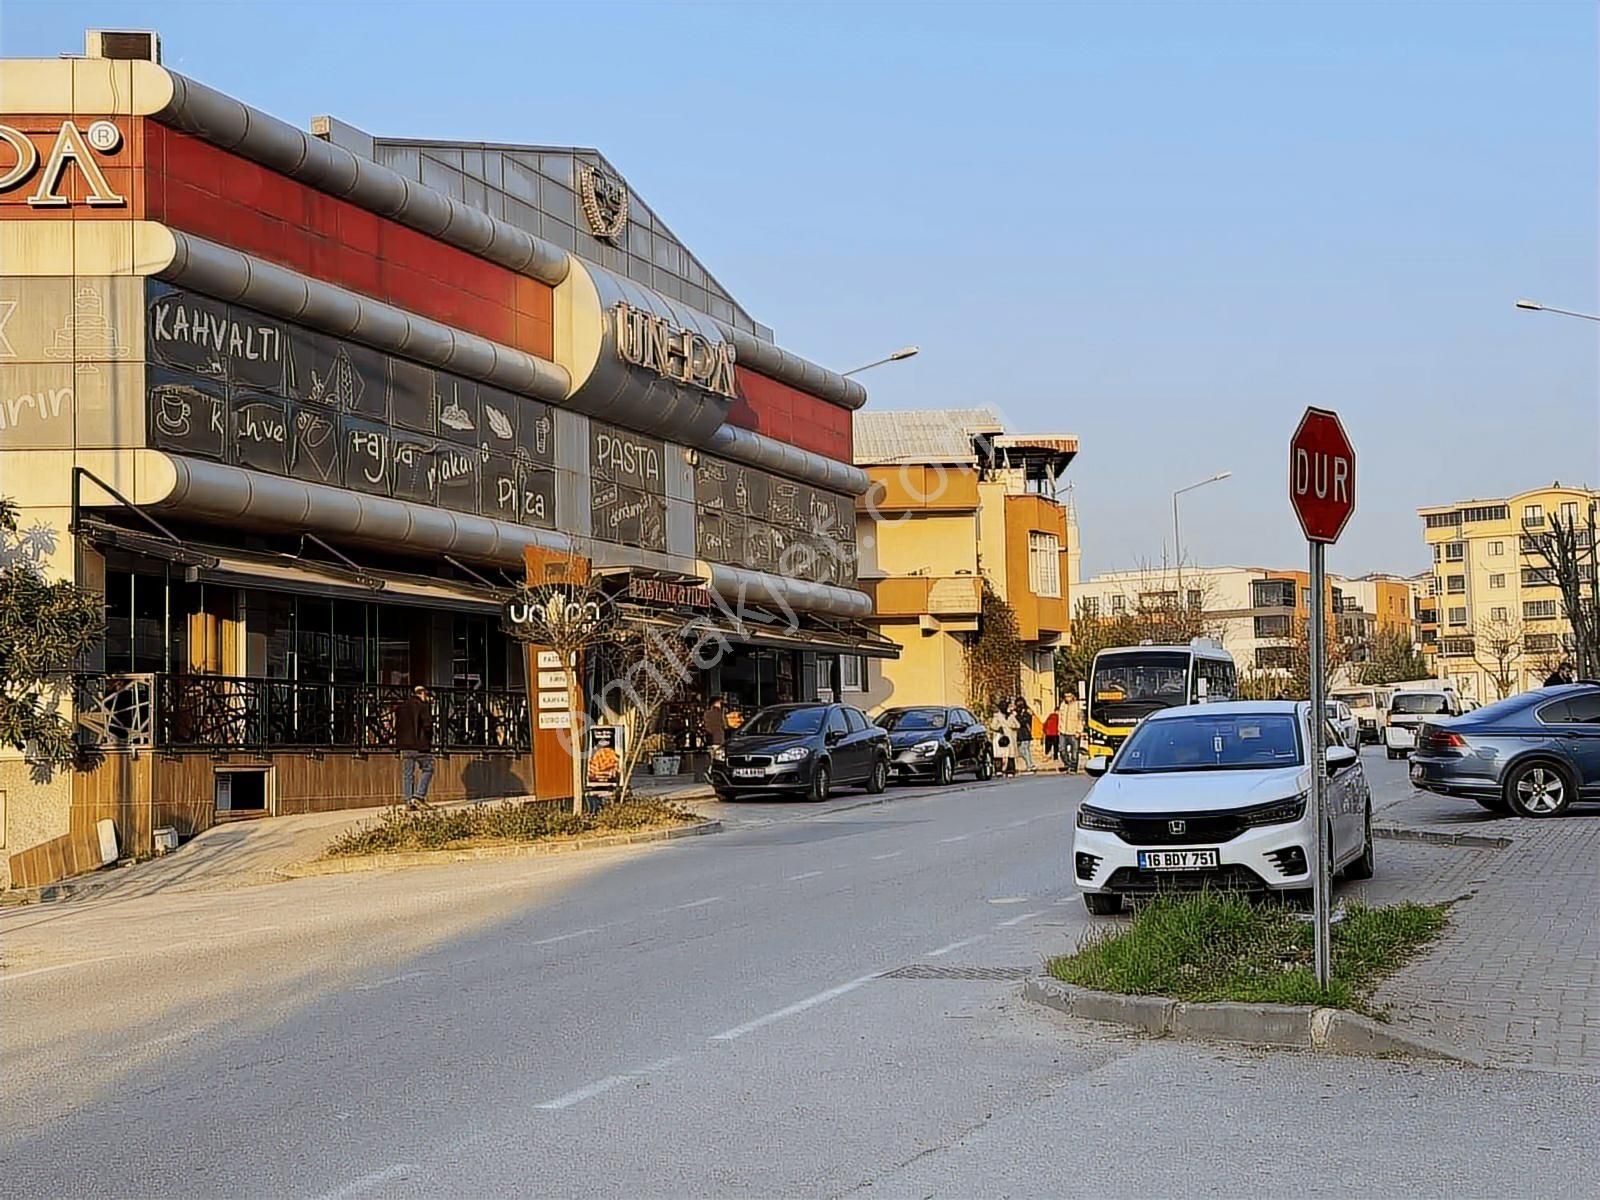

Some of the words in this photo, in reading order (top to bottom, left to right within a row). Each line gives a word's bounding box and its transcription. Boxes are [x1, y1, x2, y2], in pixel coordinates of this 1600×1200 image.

[155, 304, 280, 361] KAHVALTI
[211, 402, 285, 442] Khve
[597, 433, 659, 481] PASTA
[1297, 447, 1348, 504] DUR
[498, 477, 545, 520] Piza
[1147, 854, 1161, 867] 16
[1164, 853, 1188, 867] BDY
[1191, 851, 1214, 865] 751
